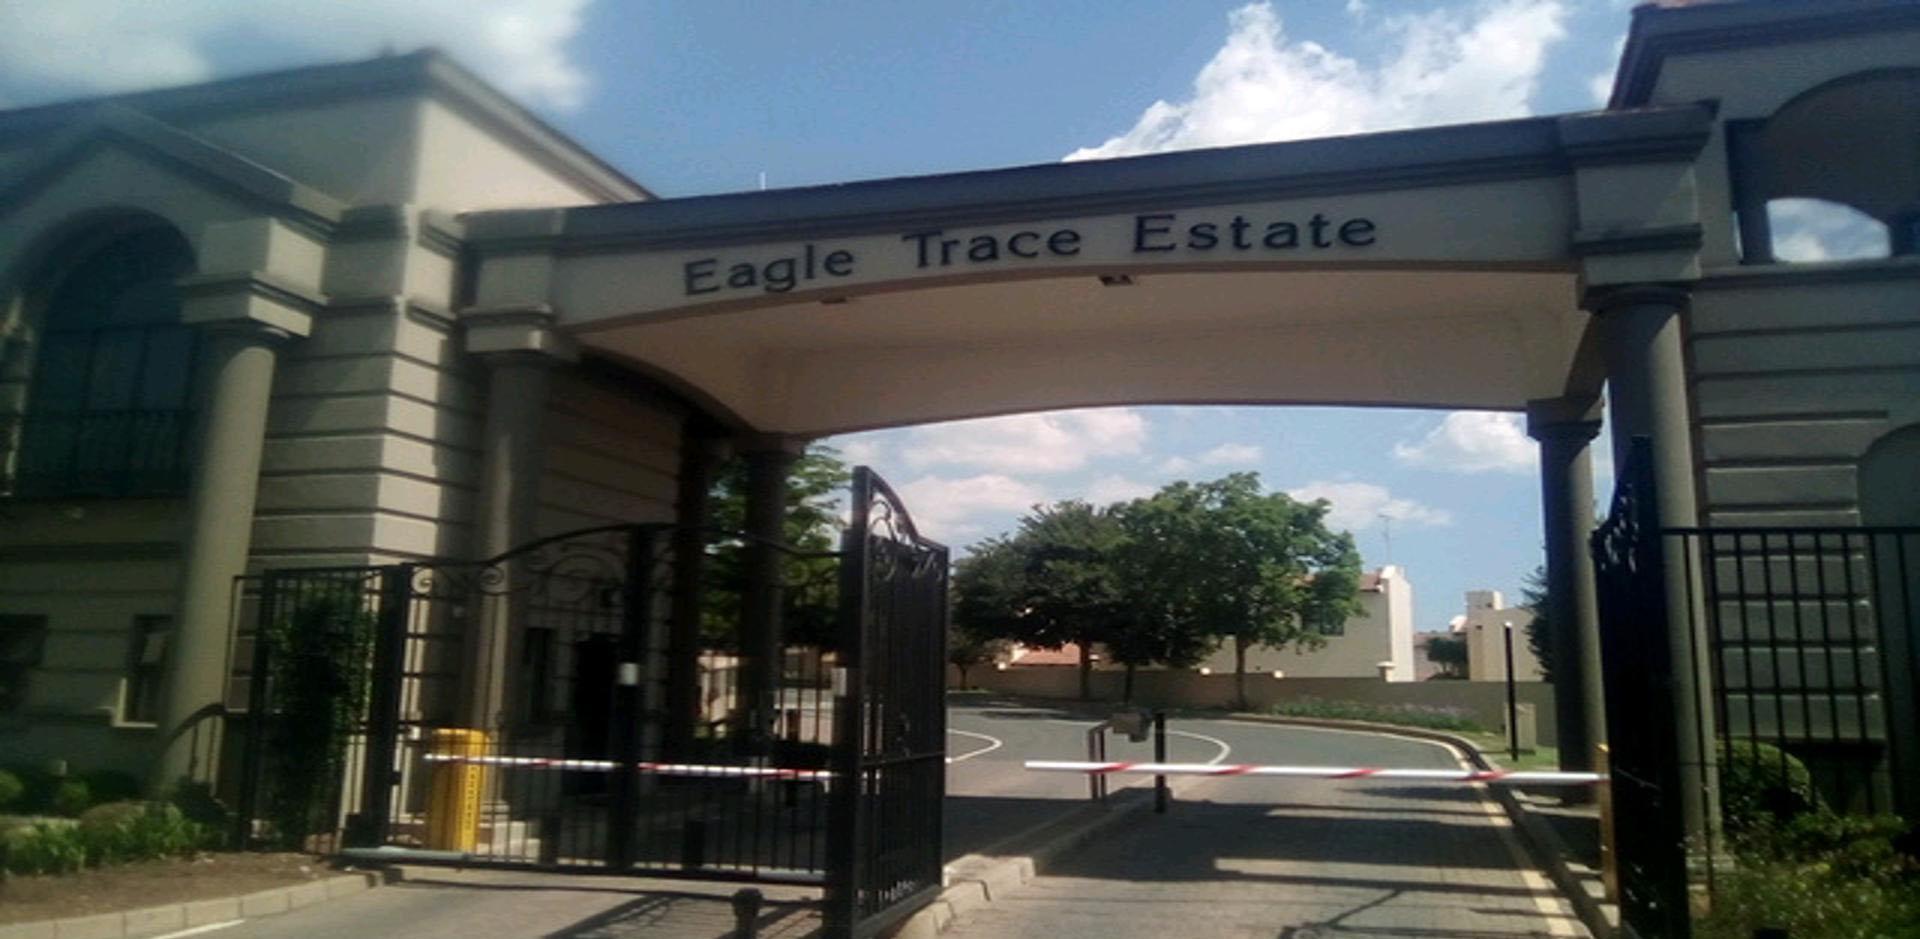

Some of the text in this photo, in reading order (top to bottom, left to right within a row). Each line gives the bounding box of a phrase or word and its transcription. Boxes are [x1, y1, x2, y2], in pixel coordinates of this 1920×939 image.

[684, 213, 1377, 293] Eagle Trace Estate
